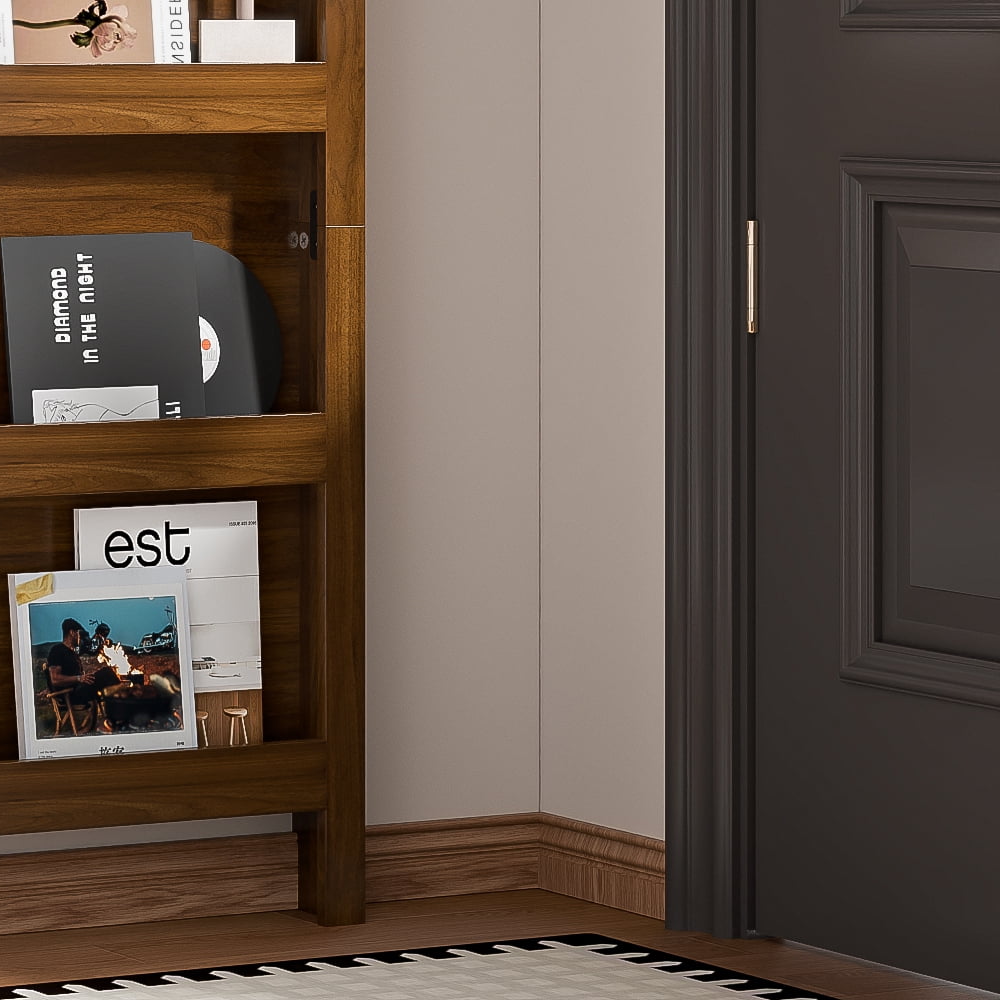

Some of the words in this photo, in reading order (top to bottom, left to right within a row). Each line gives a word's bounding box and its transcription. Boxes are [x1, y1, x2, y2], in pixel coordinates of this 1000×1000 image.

[76, 253, 95, 303] NIGHT
[50, 267, 71, 343] DIAMOND
[80, 313, 98, 342] THE
[82, 348, 100, 363] IN
[104, 521, 191, 569] est
